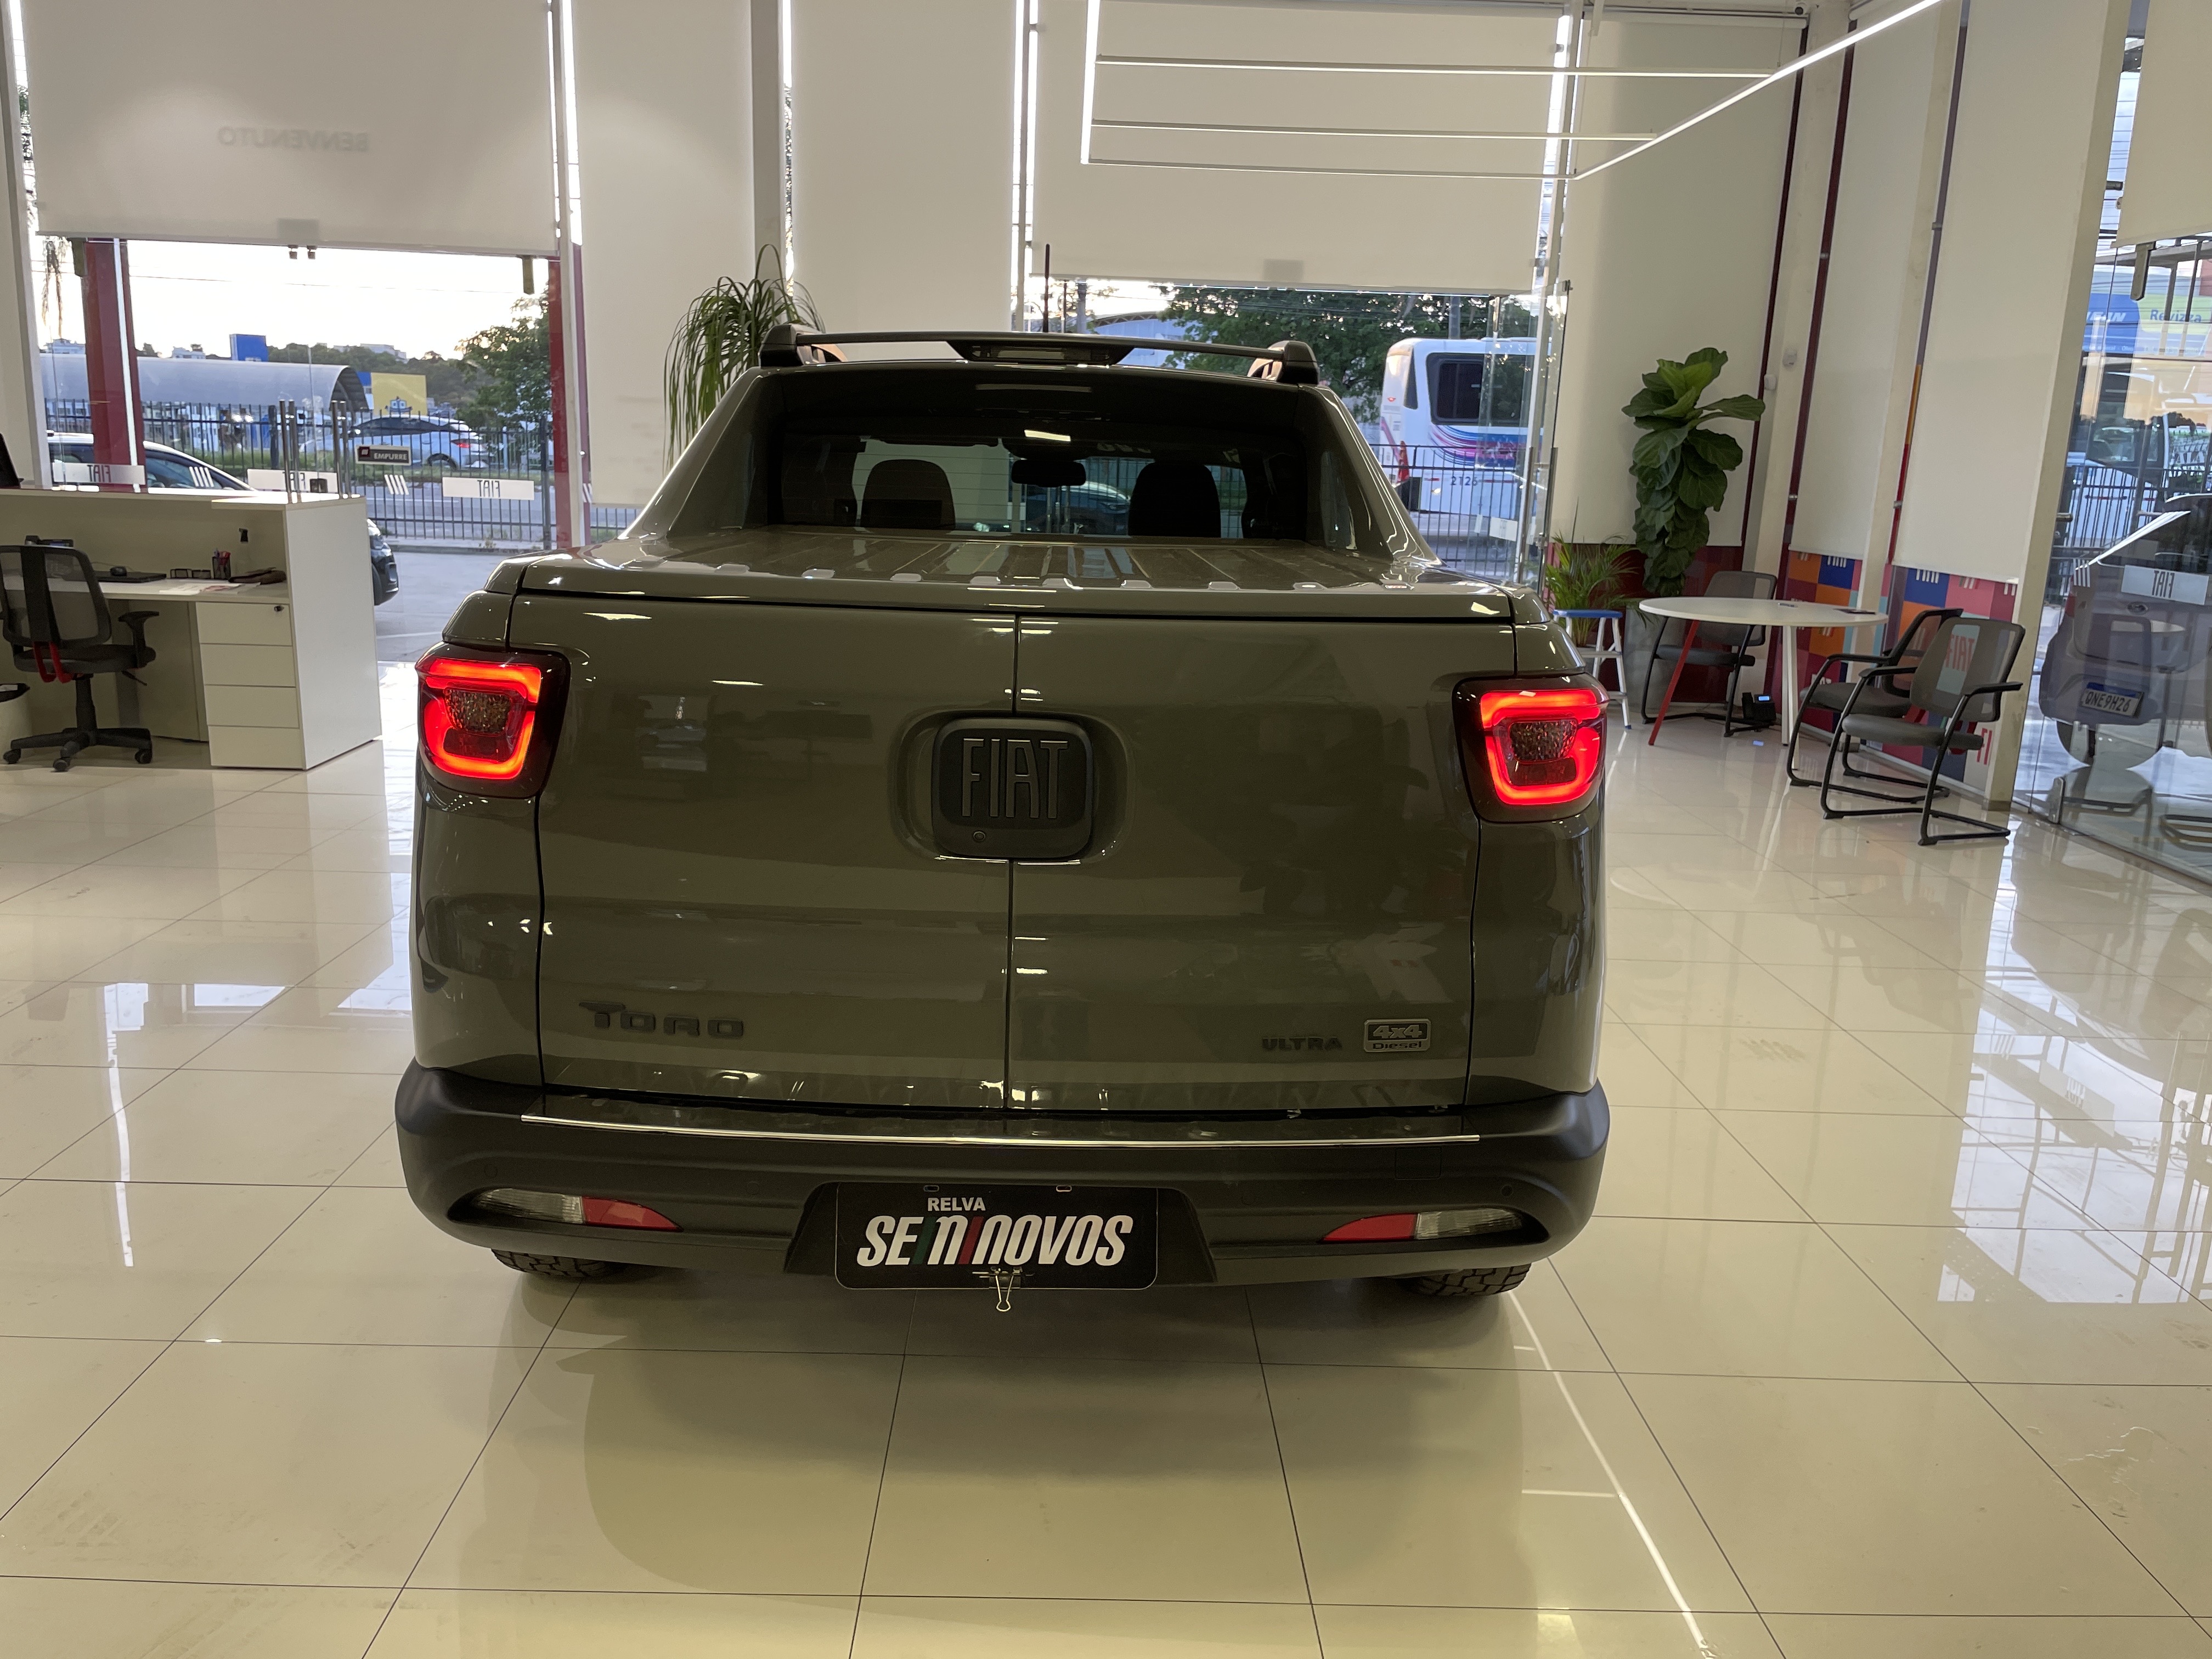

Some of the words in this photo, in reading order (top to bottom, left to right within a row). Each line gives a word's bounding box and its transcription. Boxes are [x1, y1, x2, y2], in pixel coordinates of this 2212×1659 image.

[961, 737, 1068, 819] FIAT
[1373, 1024, 1422, 1039] 4x4
[1262, 1037, 1343, 1050] ULTRA
[1373, 1041, 1422, 1049] Diesel
[927, 1197, 986, 1212] RELVA
